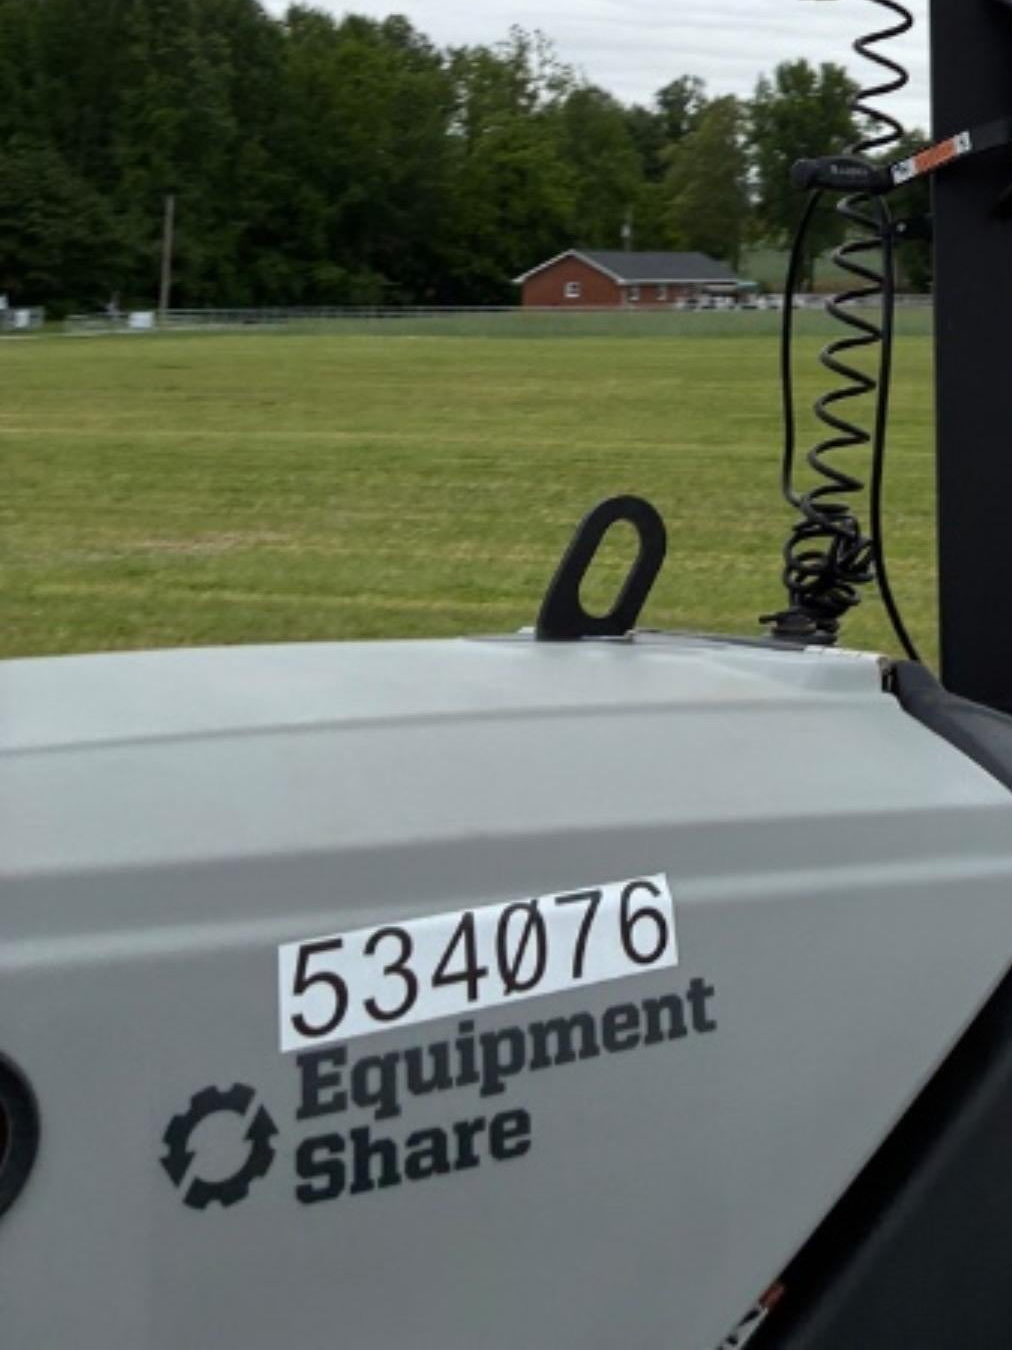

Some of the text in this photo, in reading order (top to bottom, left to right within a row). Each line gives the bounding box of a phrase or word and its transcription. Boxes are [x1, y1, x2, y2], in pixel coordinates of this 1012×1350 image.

[291, 880, 670, 1038] 534076
[296, 977, 717, 1120] Equipment
[295, 1108, 532, 1206] Share
